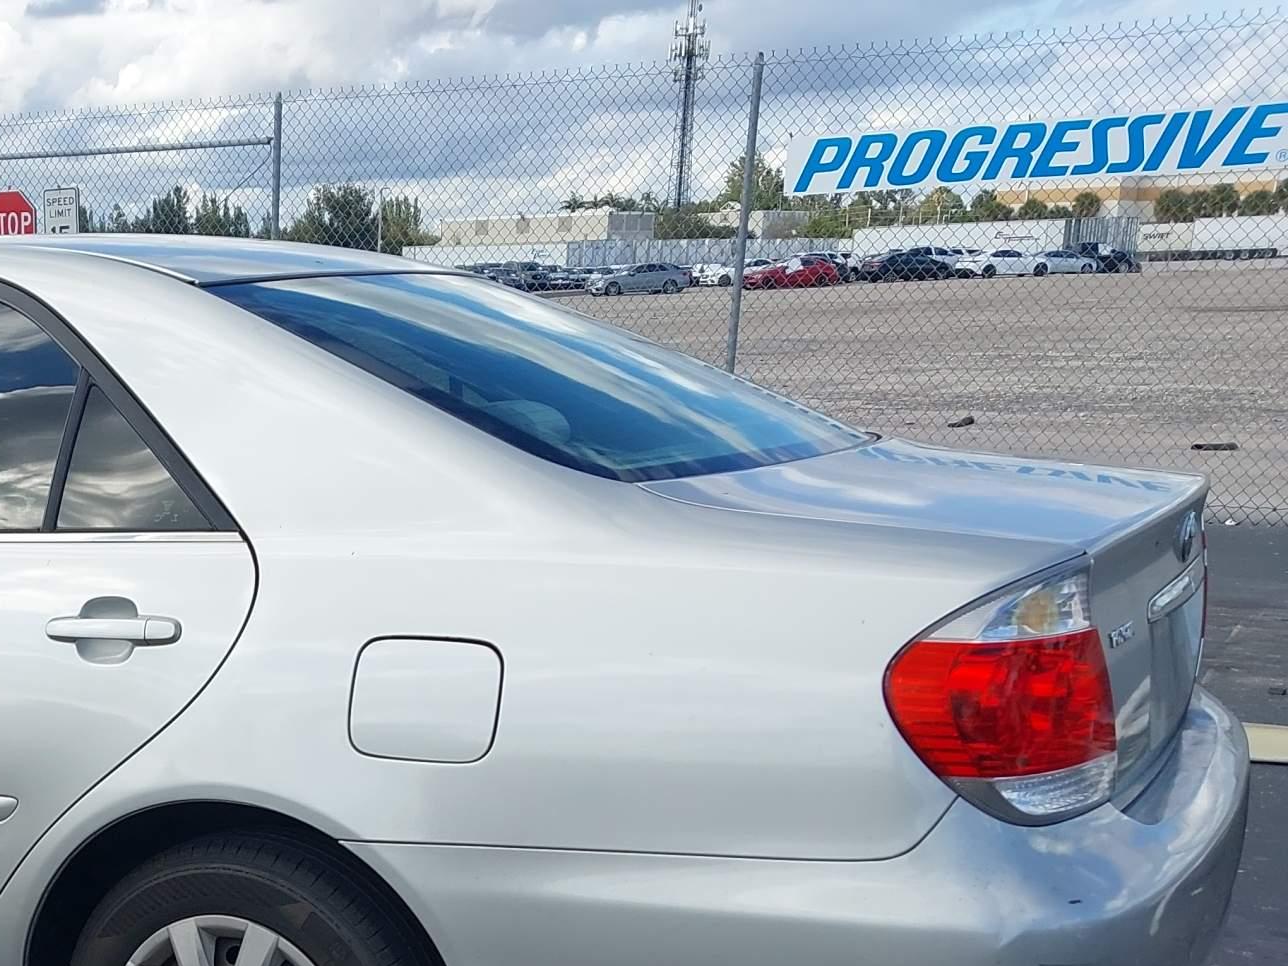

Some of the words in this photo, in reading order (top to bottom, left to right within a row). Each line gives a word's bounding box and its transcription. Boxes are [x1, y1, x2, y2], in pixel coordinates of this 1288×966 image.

[793, 102, 1288, 193] PROGRESSIVE
[46, 196, 74, 207] SPEED
[49, 208, 72, 219] LIMIT
